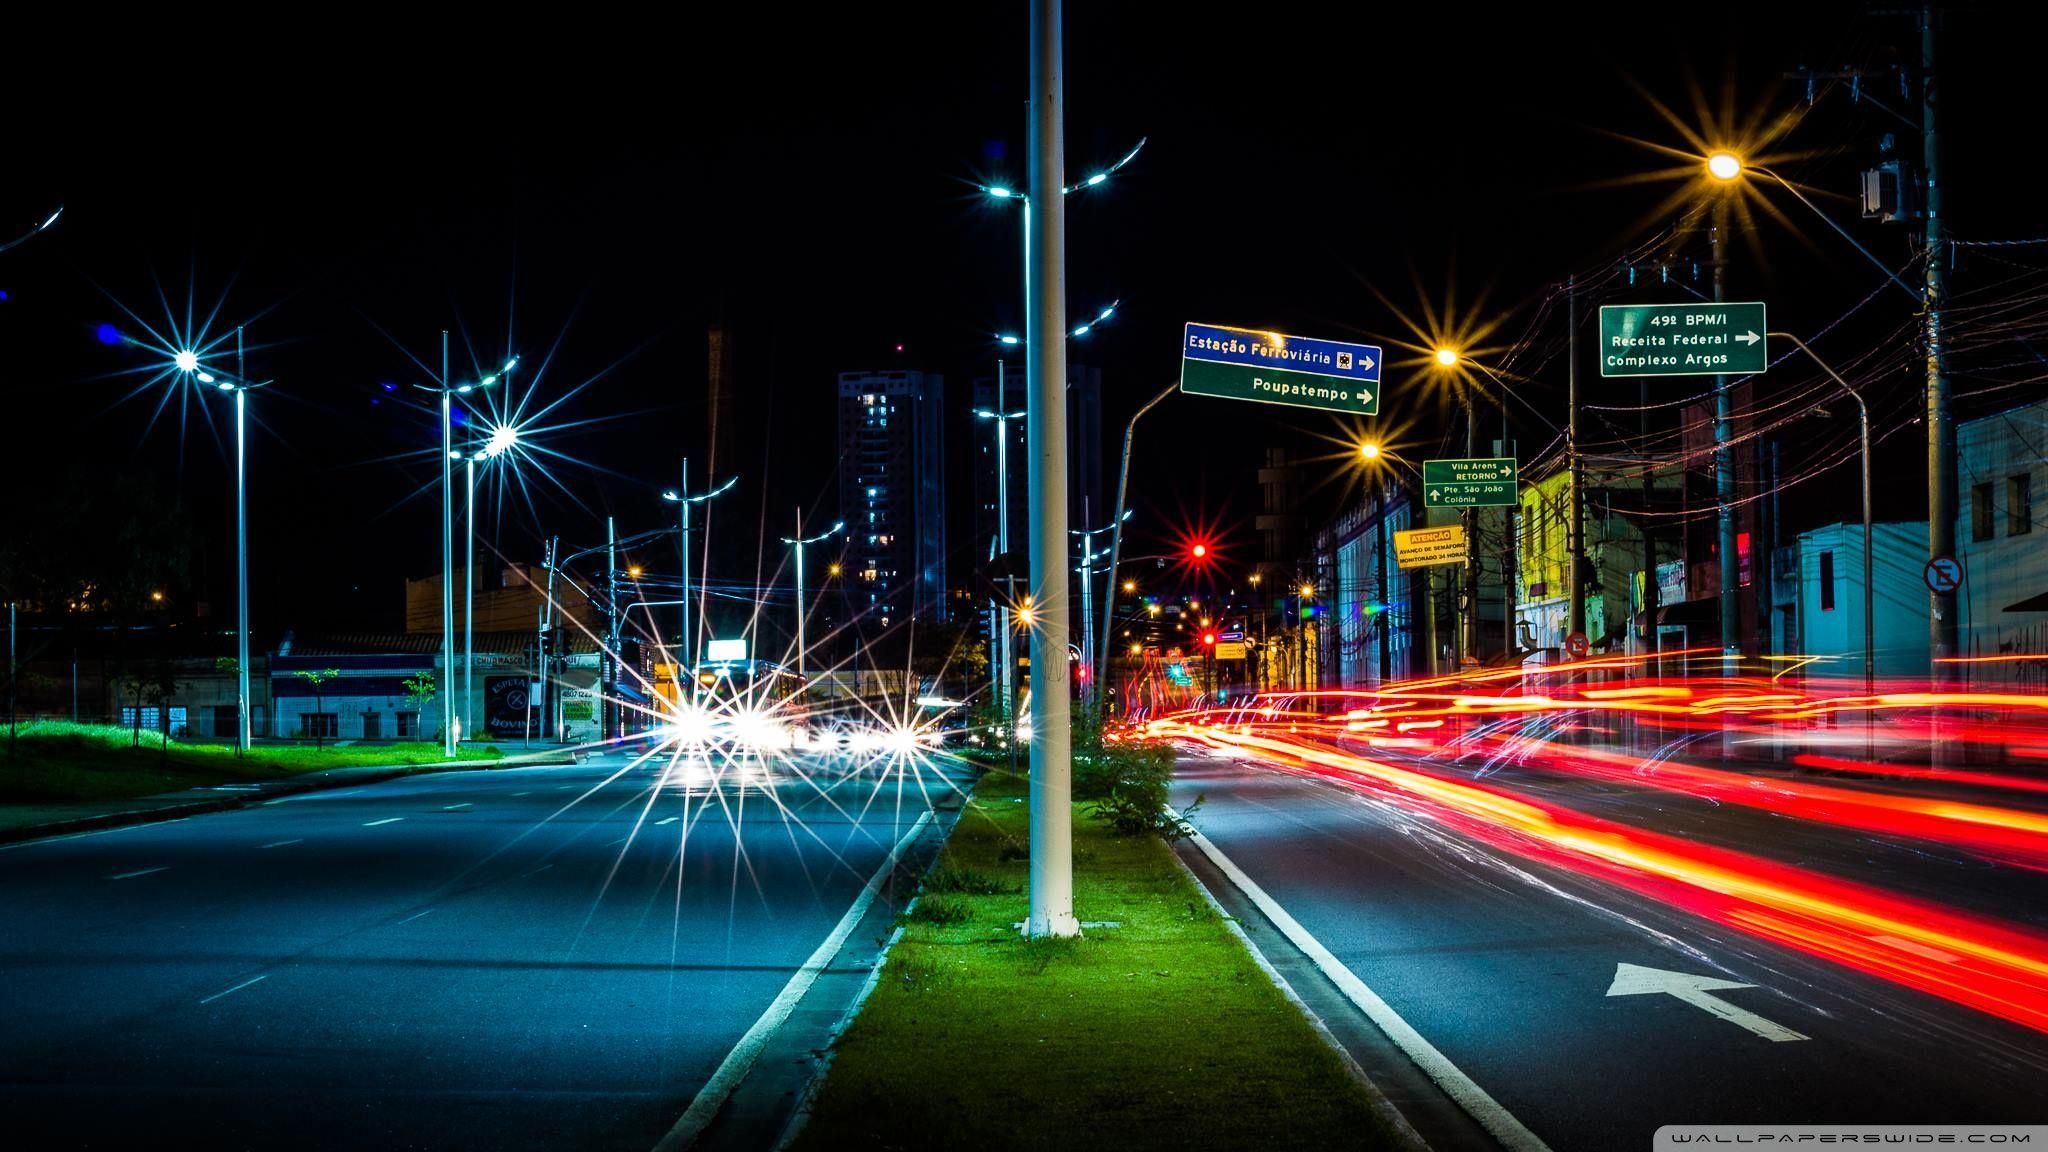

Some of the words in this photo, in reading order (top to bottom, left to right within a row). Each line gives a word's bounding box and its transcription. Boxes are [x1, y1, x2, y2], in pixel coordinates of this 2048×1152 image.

[1686, 314, 1727, 325] BPM/I
[1612, 335, 1666, 347] Receita
[1673, 333, 1728, 345] Federal
[1189, 335, 1246, 354] Estação
[1251, 343, 1331, 365] Ferroviária
[1607, 355, 1677, 368] Complexo
[1685, 353, 1728, 367] Argos
[1253, 378, 1348, 401] Poupatempo
[1456, 472, 1498, 481] RETORNO
[1464, 485, 1480, 493] São
[1483, 485, 1504, 493] João
[1444, 495, 1476, 503] Colônia
[1411, 530, 1450, 543] ATENÇÃO
[1400, 547, 1423, 555] AVANÇO
[1433, 542, 1466, 551] SEMÁFORO
[1400, 554, 1438, 563] MONITORADO
